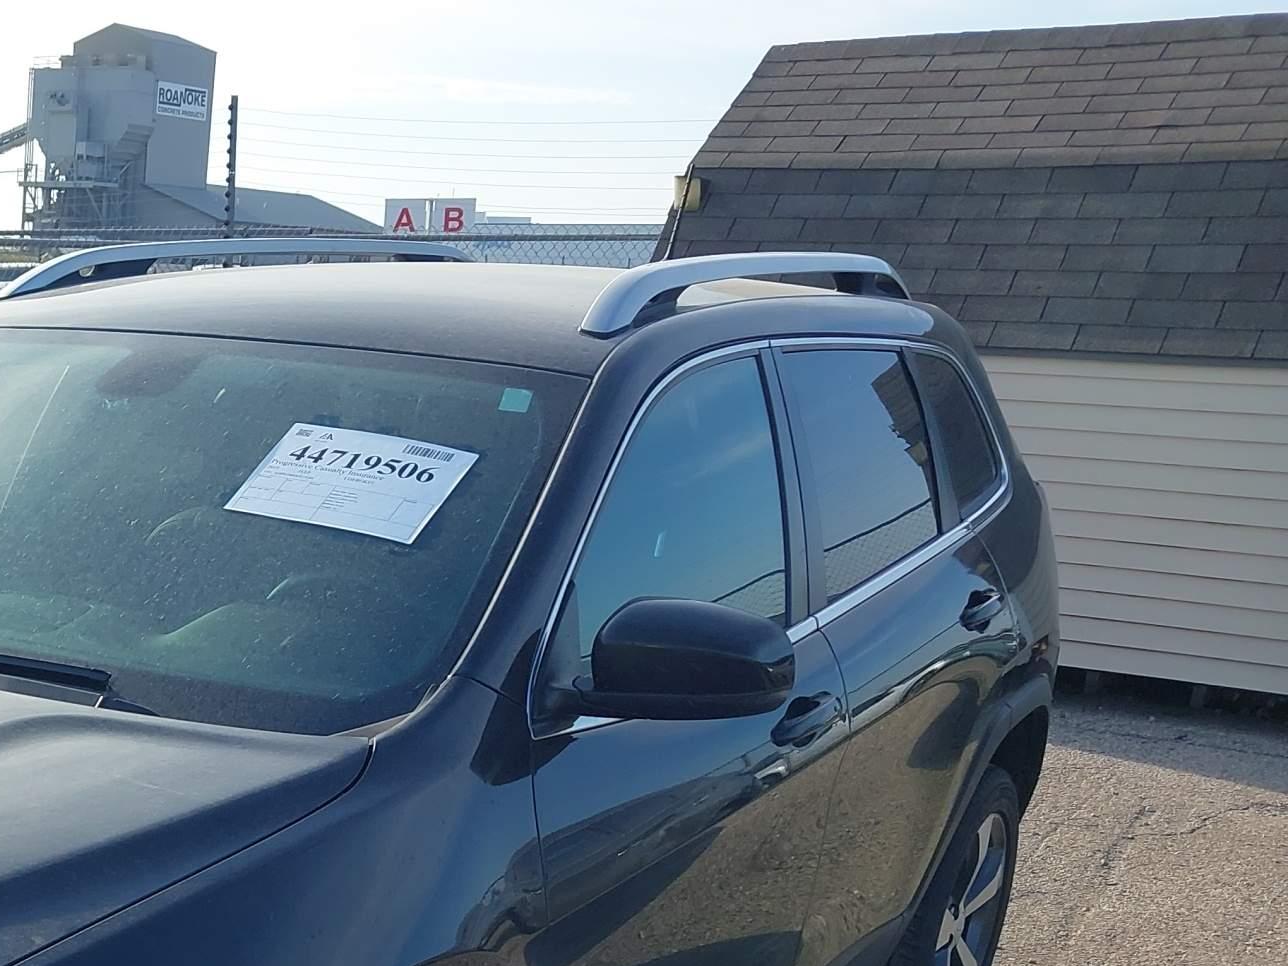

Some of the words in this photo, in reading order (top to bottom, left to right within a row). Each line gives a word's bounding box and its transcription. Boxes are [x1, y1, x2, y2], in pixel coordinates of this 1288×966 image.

[159, 87, 207, 107] ROANOKE
[393, 207, 415, 233] A
[443, 207, 464, 233] B
[272, 458, 313, 470] Progressive
[314, 464, 345, 476] Casualty
[348, 470, 385, 481] Insurance
[289, 444, 441, 483] 44719506
